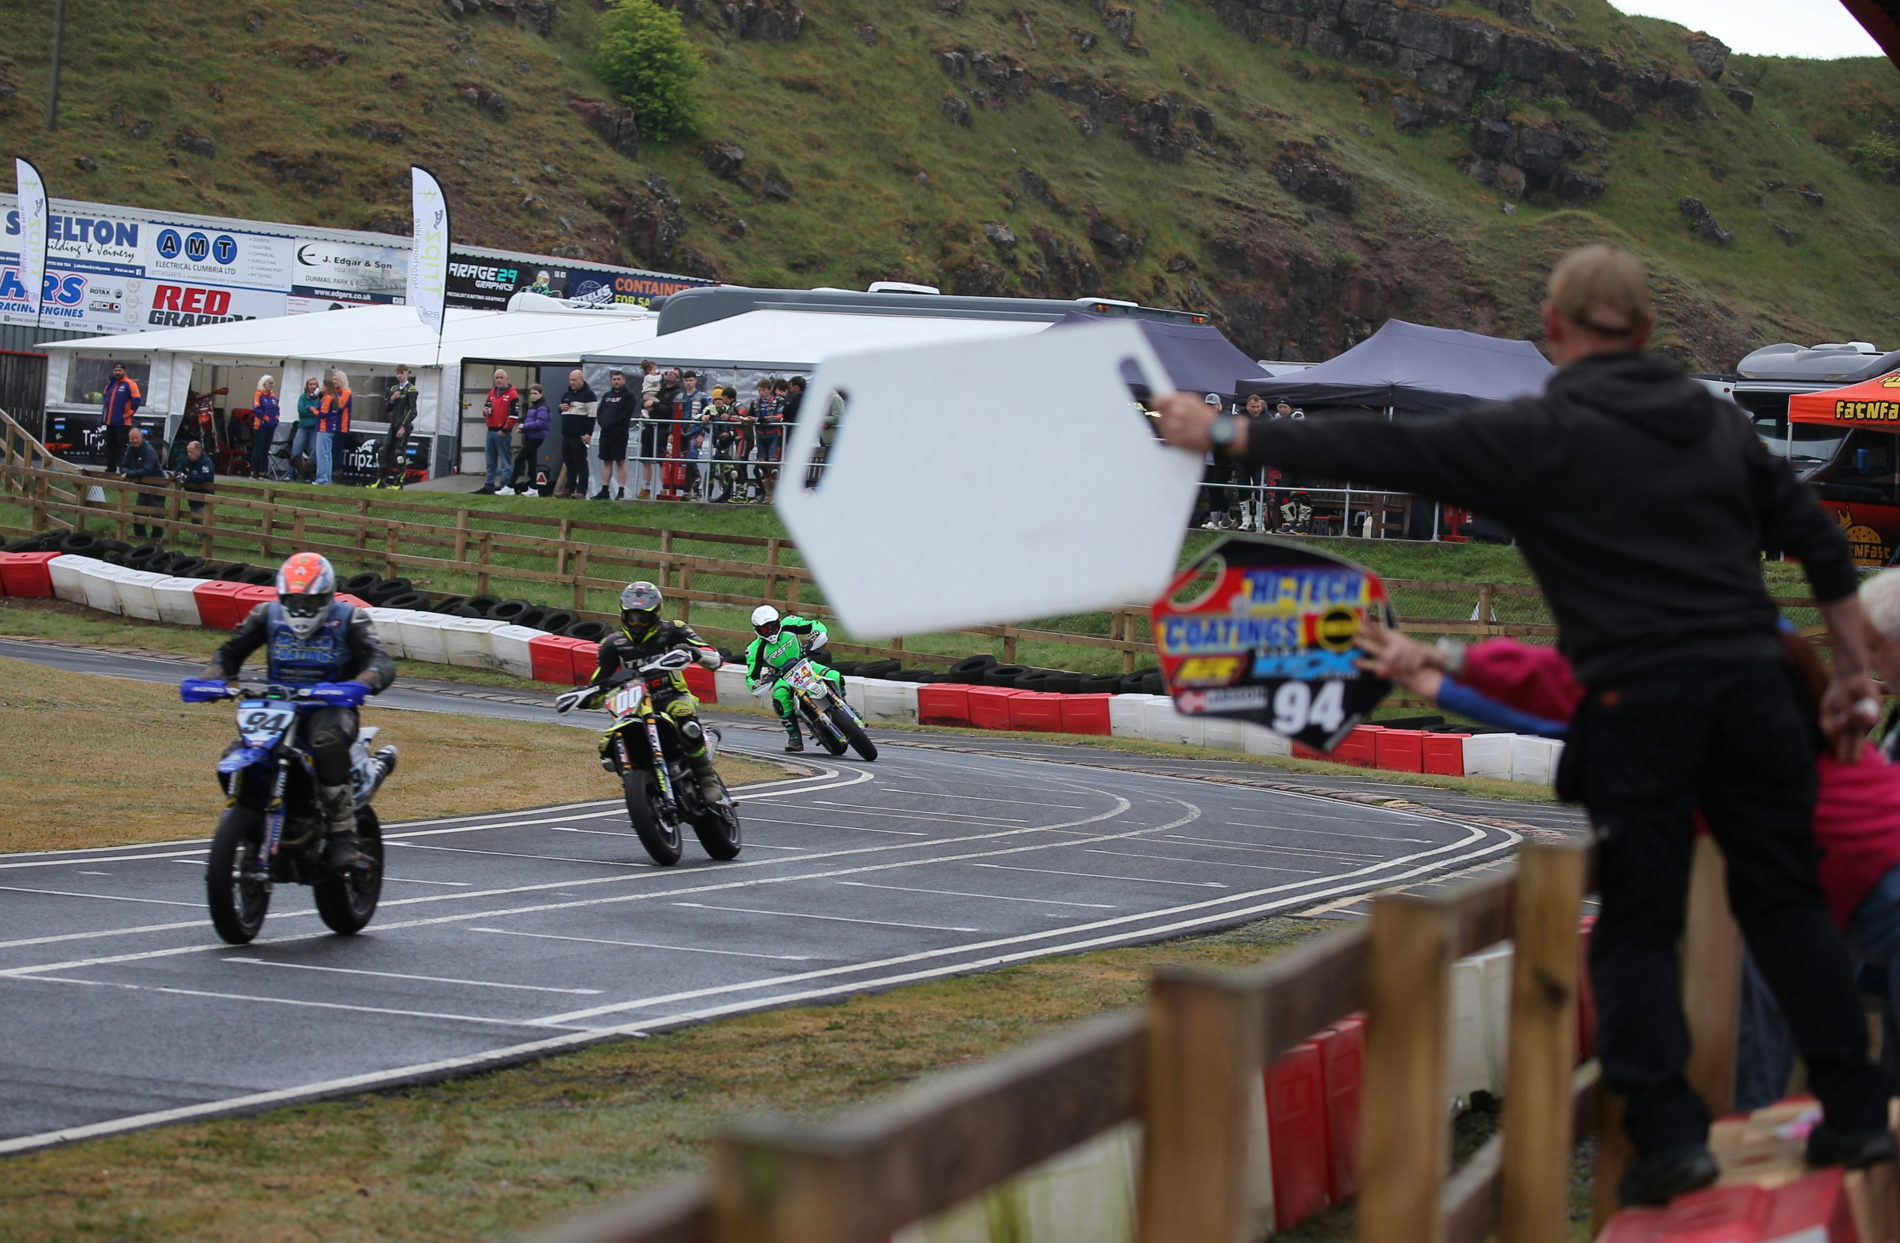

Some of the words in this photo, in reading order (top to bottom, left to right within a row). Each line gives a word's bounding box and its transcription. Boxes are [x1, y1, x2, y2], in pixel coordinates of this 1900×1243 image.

[6, 210, 139, 248] SELTON
[47, 240, 81, 259] uilding
[155, 260, 192, 271] ELECTRICAL
[193, 265, 223, 274] CUMBRIA
[224, 267, 236, 275] LTD
[334, 256, 361, 268] Edgar
[375, 261, 392, 270] Son
[305, 275, 332, 285] DUNMAIL
[448, 262, 518, 283] ARAGE29
[314, 289, 371, 301] www.edgars.co.uk
[475, 280, 515, 292] GRAPHICS
[615, 277, 697, 296] CONTAINE
[152, 284, 231, 316] RED
[615, 295, 635, 304] FOR
[638, 297, 652, 307] SA
[40, 305, 84, 319] ENGINES
[148, 310, 256, 327] GRAPH
[1163, 615, 1300, 651] COATINGS
[1271, 680, 1345, 735] 94
[242, 712, 287, 736] 94
